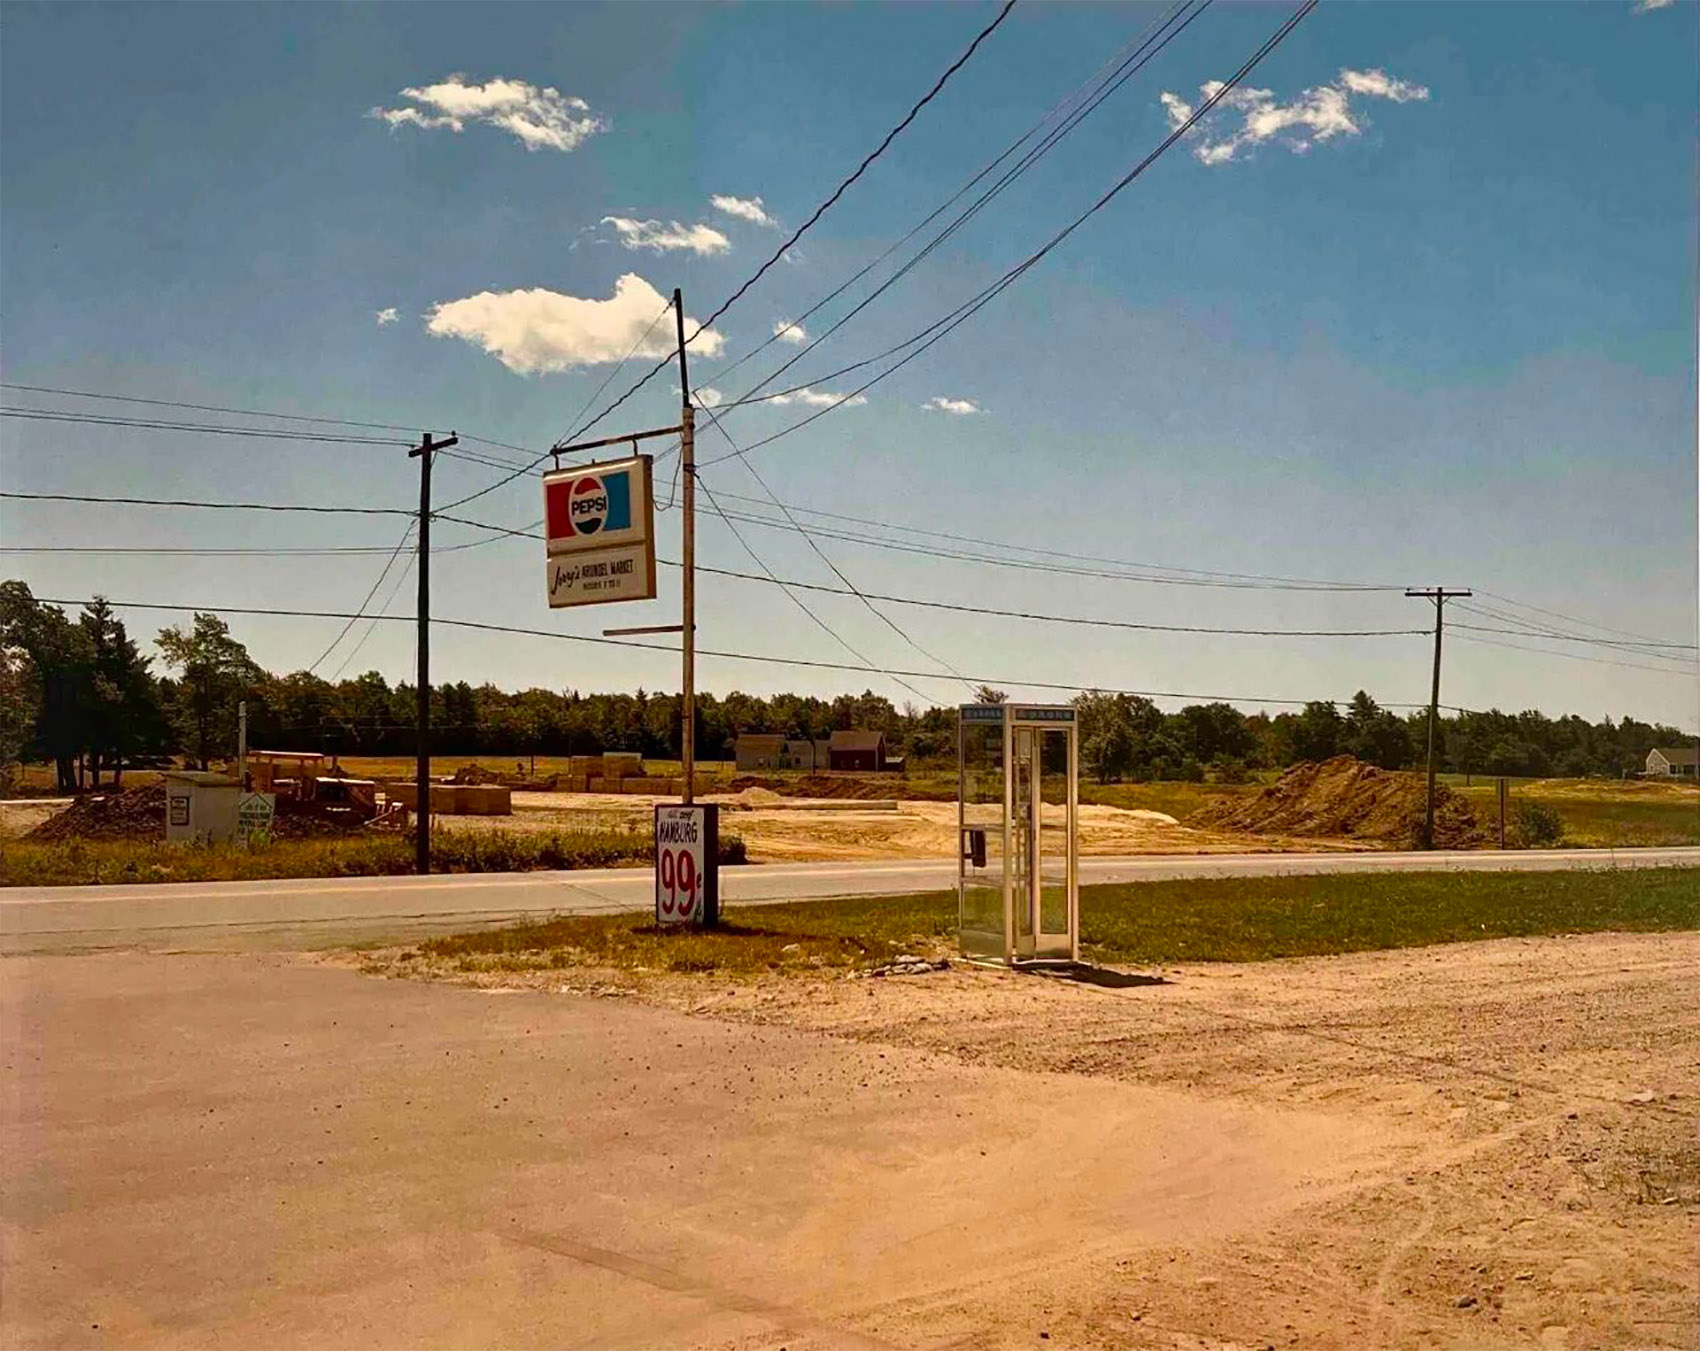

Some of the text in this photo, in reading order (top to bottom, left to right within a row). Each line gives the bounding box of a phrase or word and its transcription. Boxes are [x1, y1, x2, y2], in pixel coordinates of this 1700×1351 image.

[571, 496, 607, 515] PEPSI
[610, 559, 633, 574] MARKET
[659, 821, 698, 843] HAMBURG
